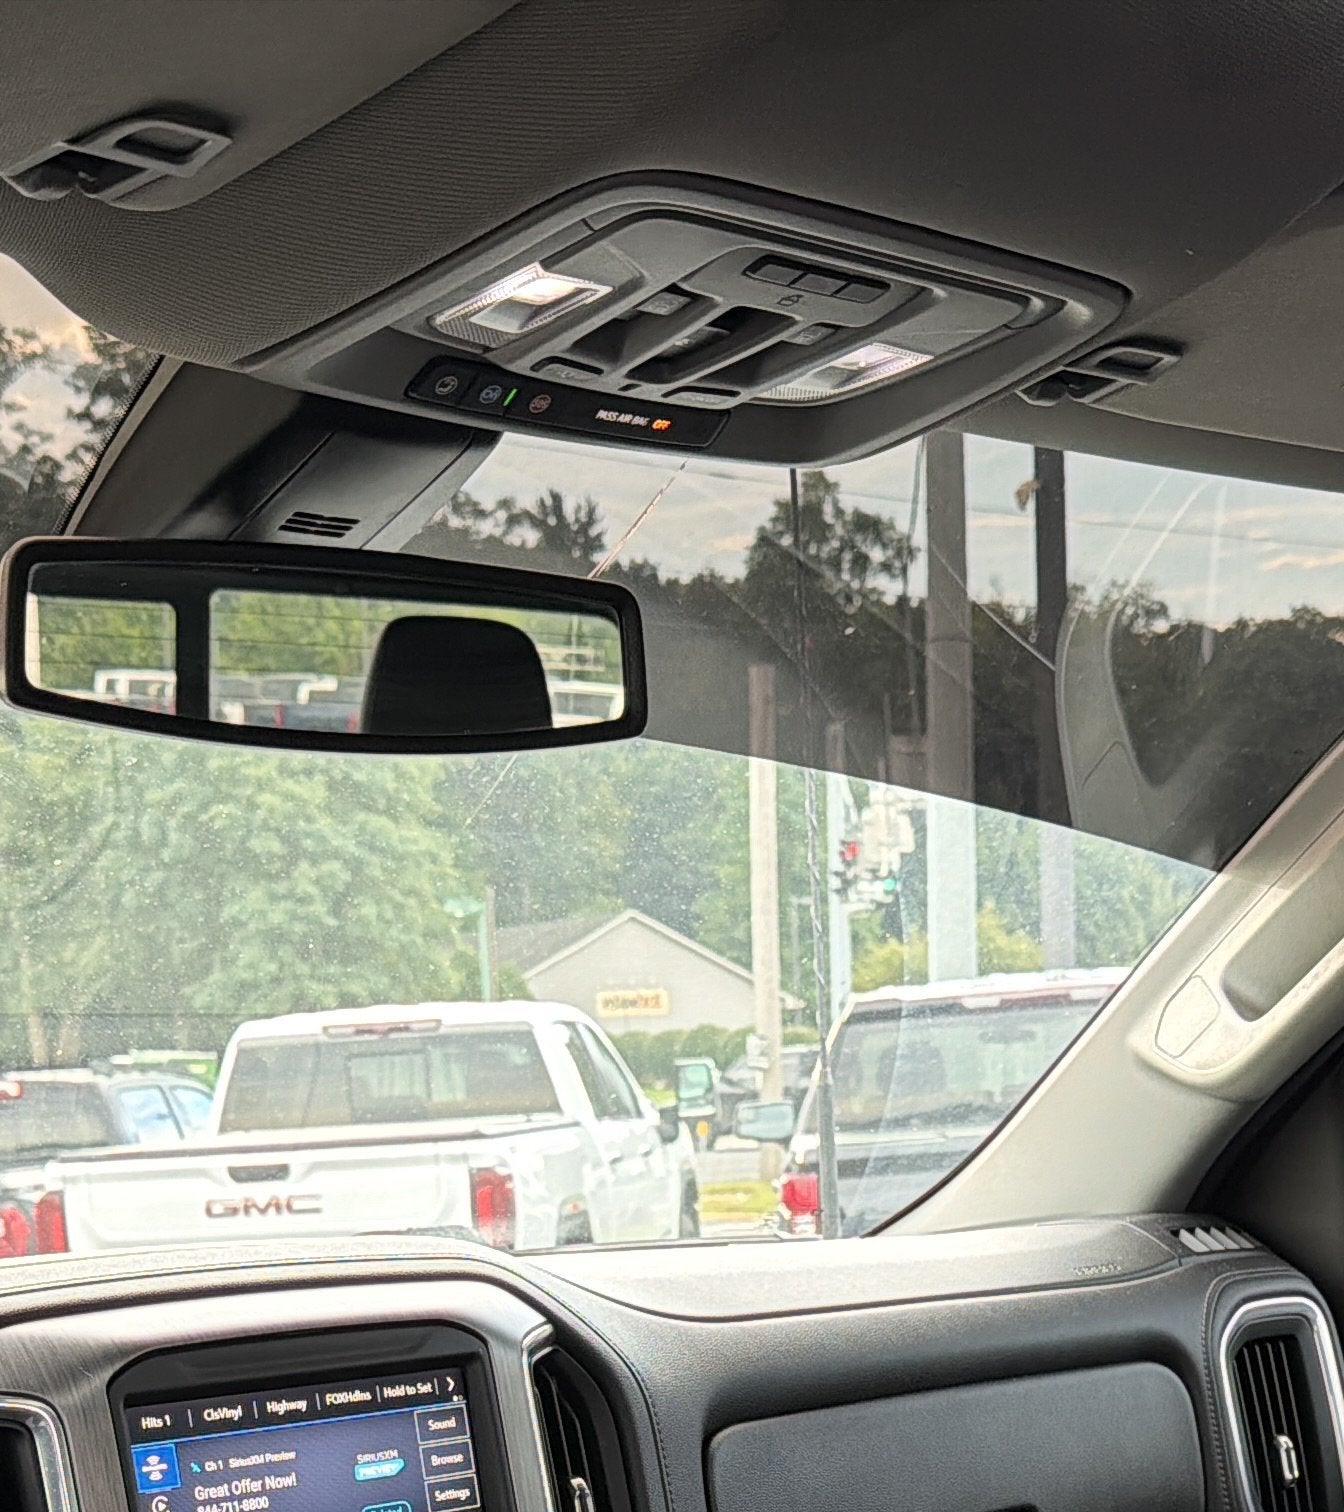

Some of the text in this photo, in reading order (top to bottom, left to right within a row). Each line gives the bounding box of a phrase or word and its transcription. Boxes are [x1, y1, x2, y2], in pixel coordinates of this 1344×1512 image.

[595, 409, 617, 422] PASS
[617, 413, 632, 424] AIR
[205, 1194, 323, 1219] GMC
[383, 1381, 433, 1399] Hold to Set
[266, 1398, 307, 1415] Highway
[141, 1414, 171, 1430] Hits 1
[428, 1416, 457, 1431] Sound
[205, 1461, 217, 1472] Ch
[217, 1459, 224, 1471] 1
[431, 1452, 464, 1467] Browse
[194, 1471, 297, 1501] Great Offer Now!
[435, 1487, 471, 1502] Settings
